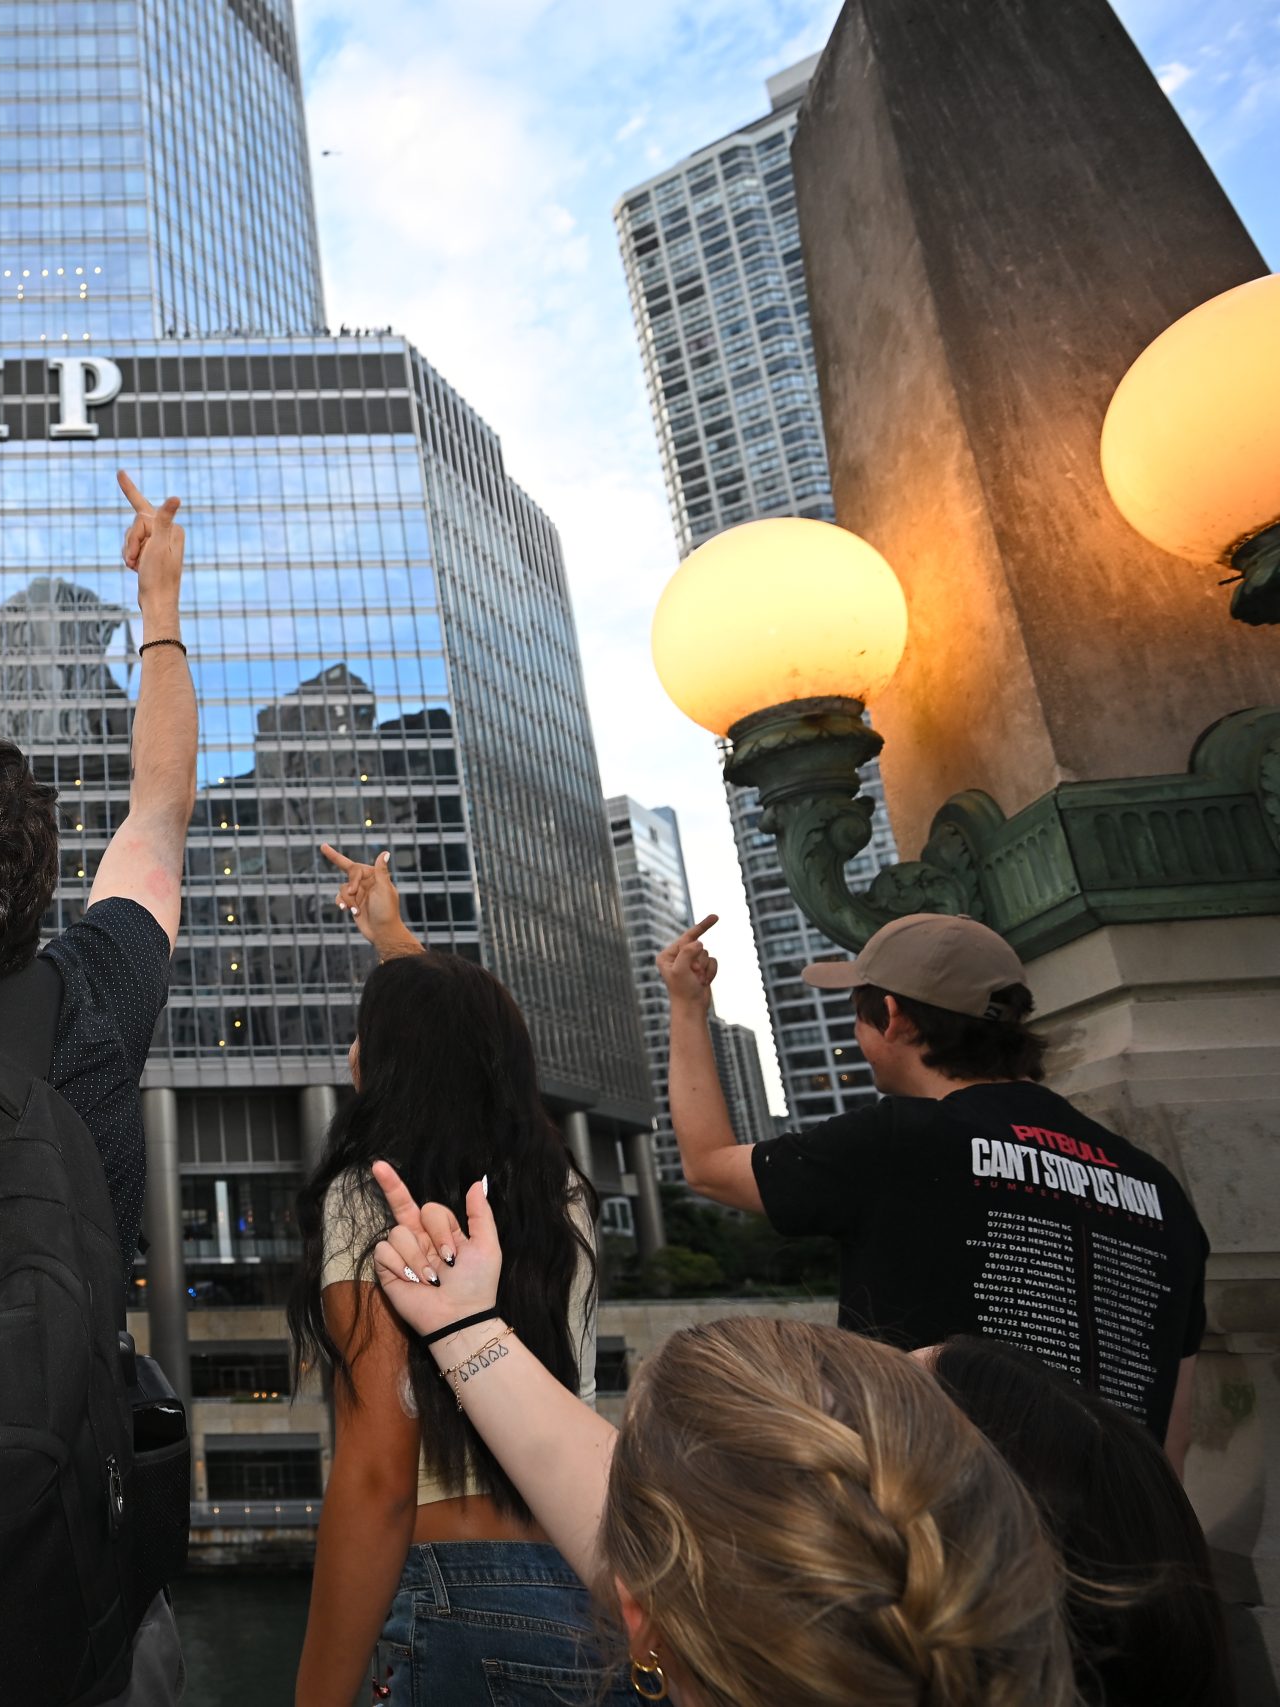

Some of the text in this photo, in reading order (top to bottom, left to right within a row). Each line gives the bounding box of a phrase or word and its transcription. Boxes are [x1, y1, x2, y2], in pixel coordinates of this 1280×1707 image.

[1010, 1124, 1119, 1168] PITBULL
[971, 1137, 1164, 1221] CAN'T STOP US NOW
[973, 1179, 1060, 1200] SUMMER
[988, 1210, 1025, 1221] 07/28/22
[1028, 1216, 1060, 1228] RALEIGH
[987, 1221, 1025, 1231] 07/29/22
[1028, 1227, 1061, 1239] BRISTOW
[987, 1231, 1025, 1242] 07/30/22
[1028, 1237, 1062, 1249] HERSHEY
[966, 1240, 1007, 1249] 07/31/22
[1009, 1245, 1041, 1255] DARIEN
[1043, 1250, 1062, 1260] LAKE
[985, 1262, 1025, 1273] 08/03/22
[1027, 1269, 1065, 1281] HOLMDEL
[989, 1252, 1028, 1263] 08/02/22
[1030, 1259, 1064, 1271] CAMDEN
[973, 1282, 1014, 1293] 08/06/22
[1017, 1288, 1067, 1303] UNCASVILLE
[981, 1273, 1022, 1283] 08/05/22
[1024, 1279, 1065, 1292] WANTAGH
[974, 1293, 1014, 1304] 08/09/22
[1017, 1299, 1065, 1313] MANSFIELD
[988, 1305, 1079, 1328] 08/11/22 BANGOR ME
[977, 1315, 1080, 1339] 08/12/22 MONTREAL QC
[982, 1326, 1080, 1351] 08/13/22 TORONTO ON
[1036, 1347, 1068, 1359] OMAHA
[1070, 1354, 1081, 1362] NE
[1070, 1366, 1081, 1374] CO
